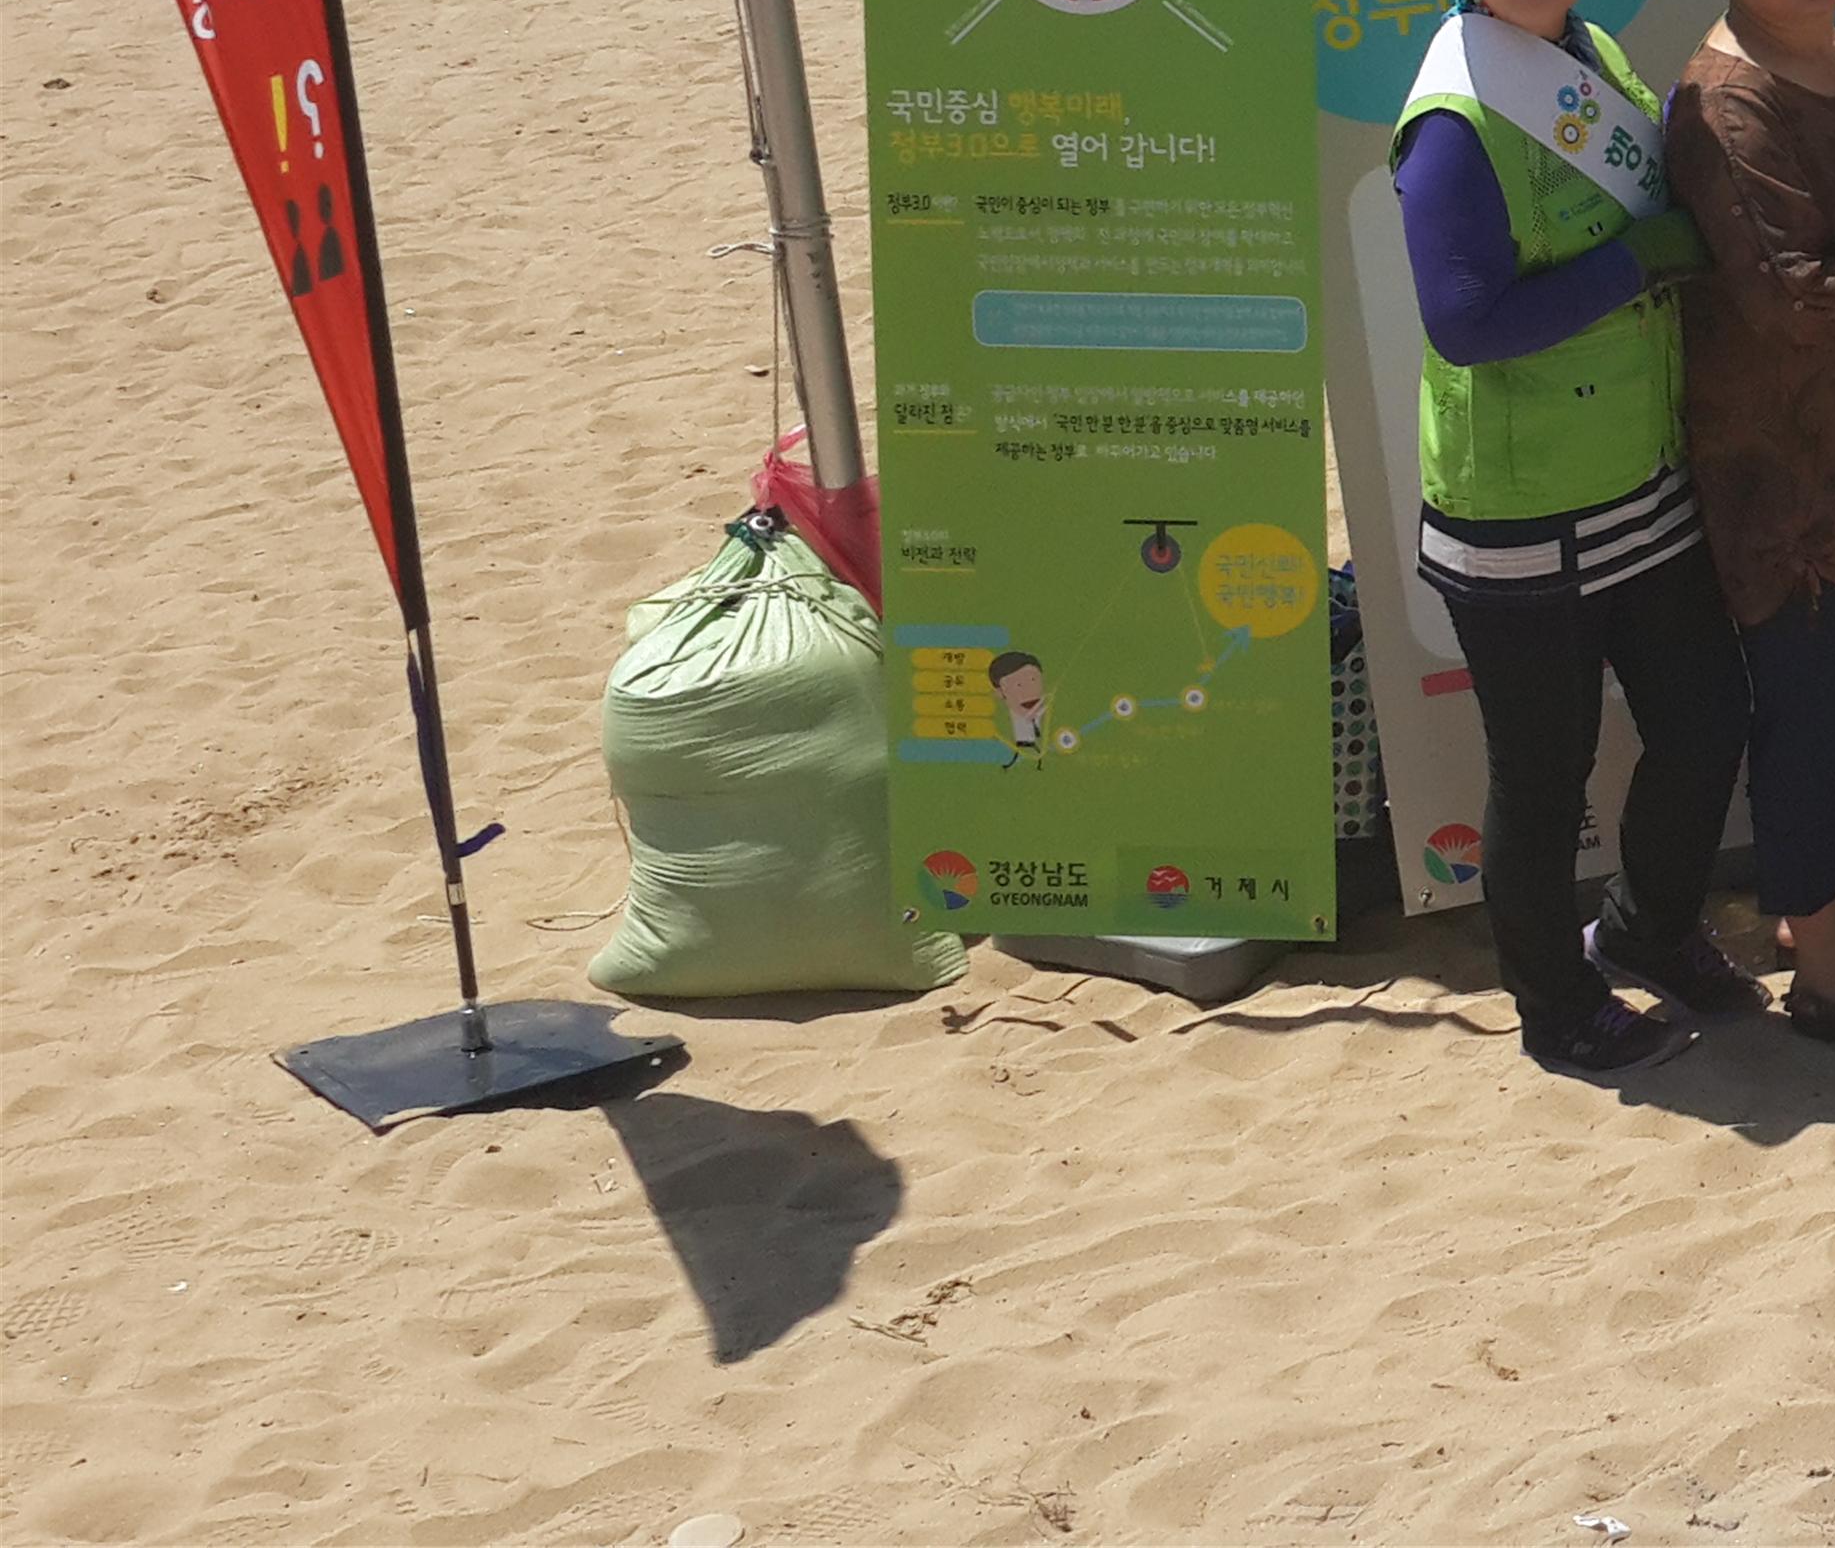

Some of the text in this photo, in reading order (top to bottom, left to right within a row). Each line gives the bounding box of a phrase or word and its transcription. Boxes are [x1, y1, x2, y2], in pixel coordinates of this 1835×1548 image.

[887, 89, 999, 126] 국민중심
[1052, 131, 1109, 169] 열어
[1119, 132, 1217, 170] 갑니다!
[989, 860, 1089, 890] 경상남도
[990, 891, 1089, 909] GYEONGNAM
